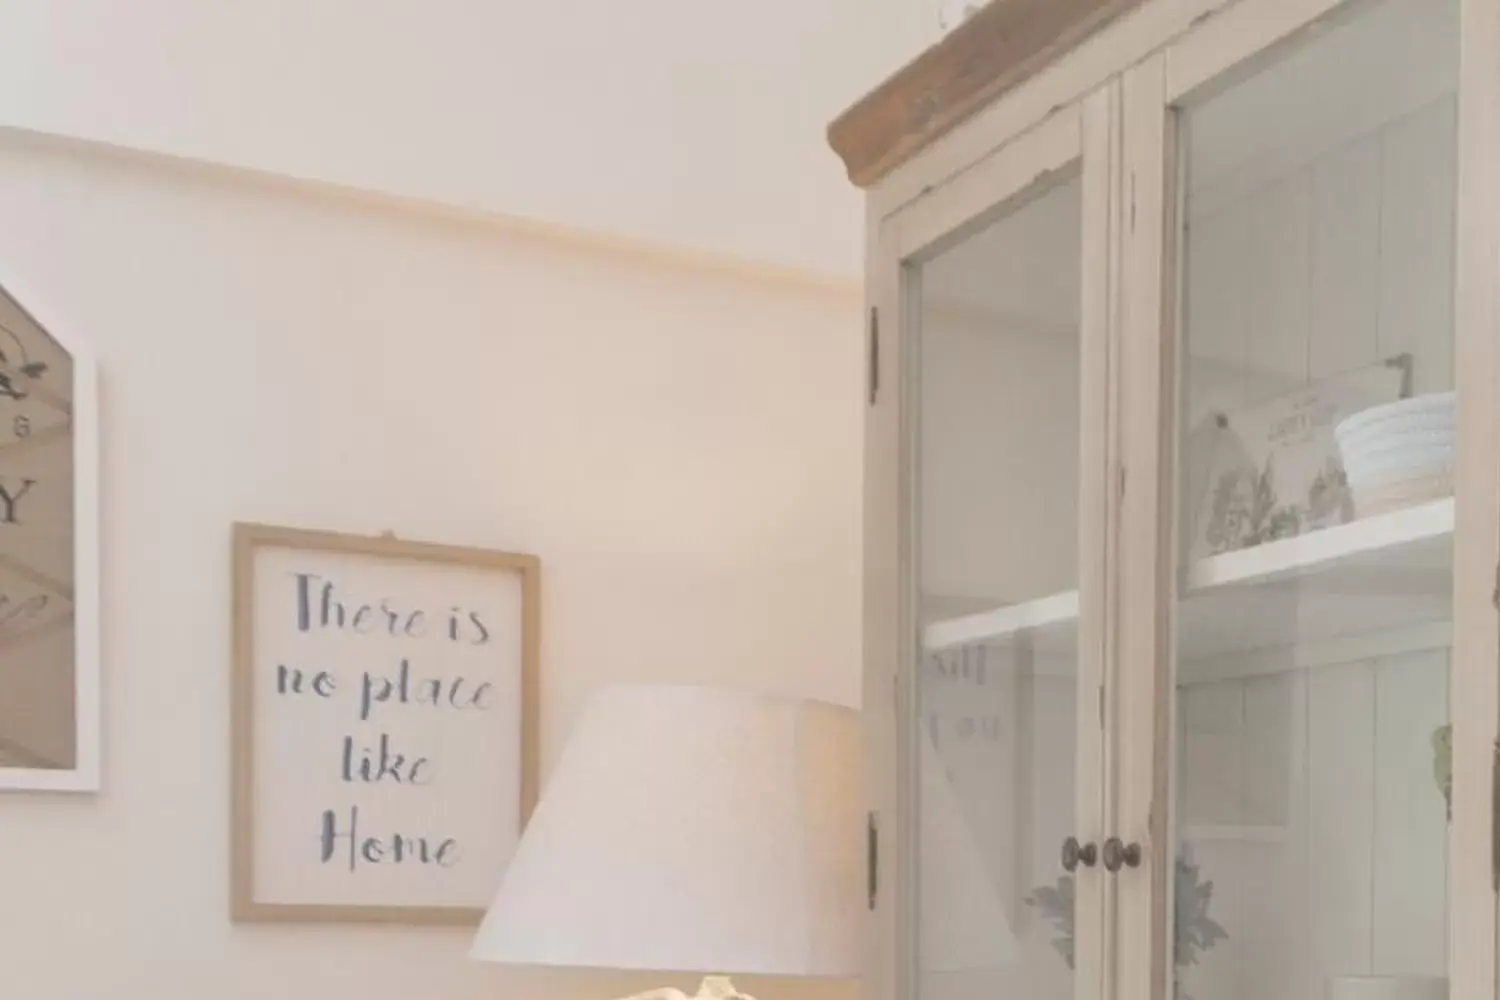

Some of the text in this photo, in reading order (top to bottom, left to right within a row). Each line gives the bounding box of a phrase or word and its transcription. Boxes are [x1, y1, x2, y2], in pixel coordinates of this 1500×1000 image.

[291, 571, 493, 647] There is
[276, 657, 494, 722] no place
[339, 732, 431, 786] like
[315, 804, 461, 873] Home
